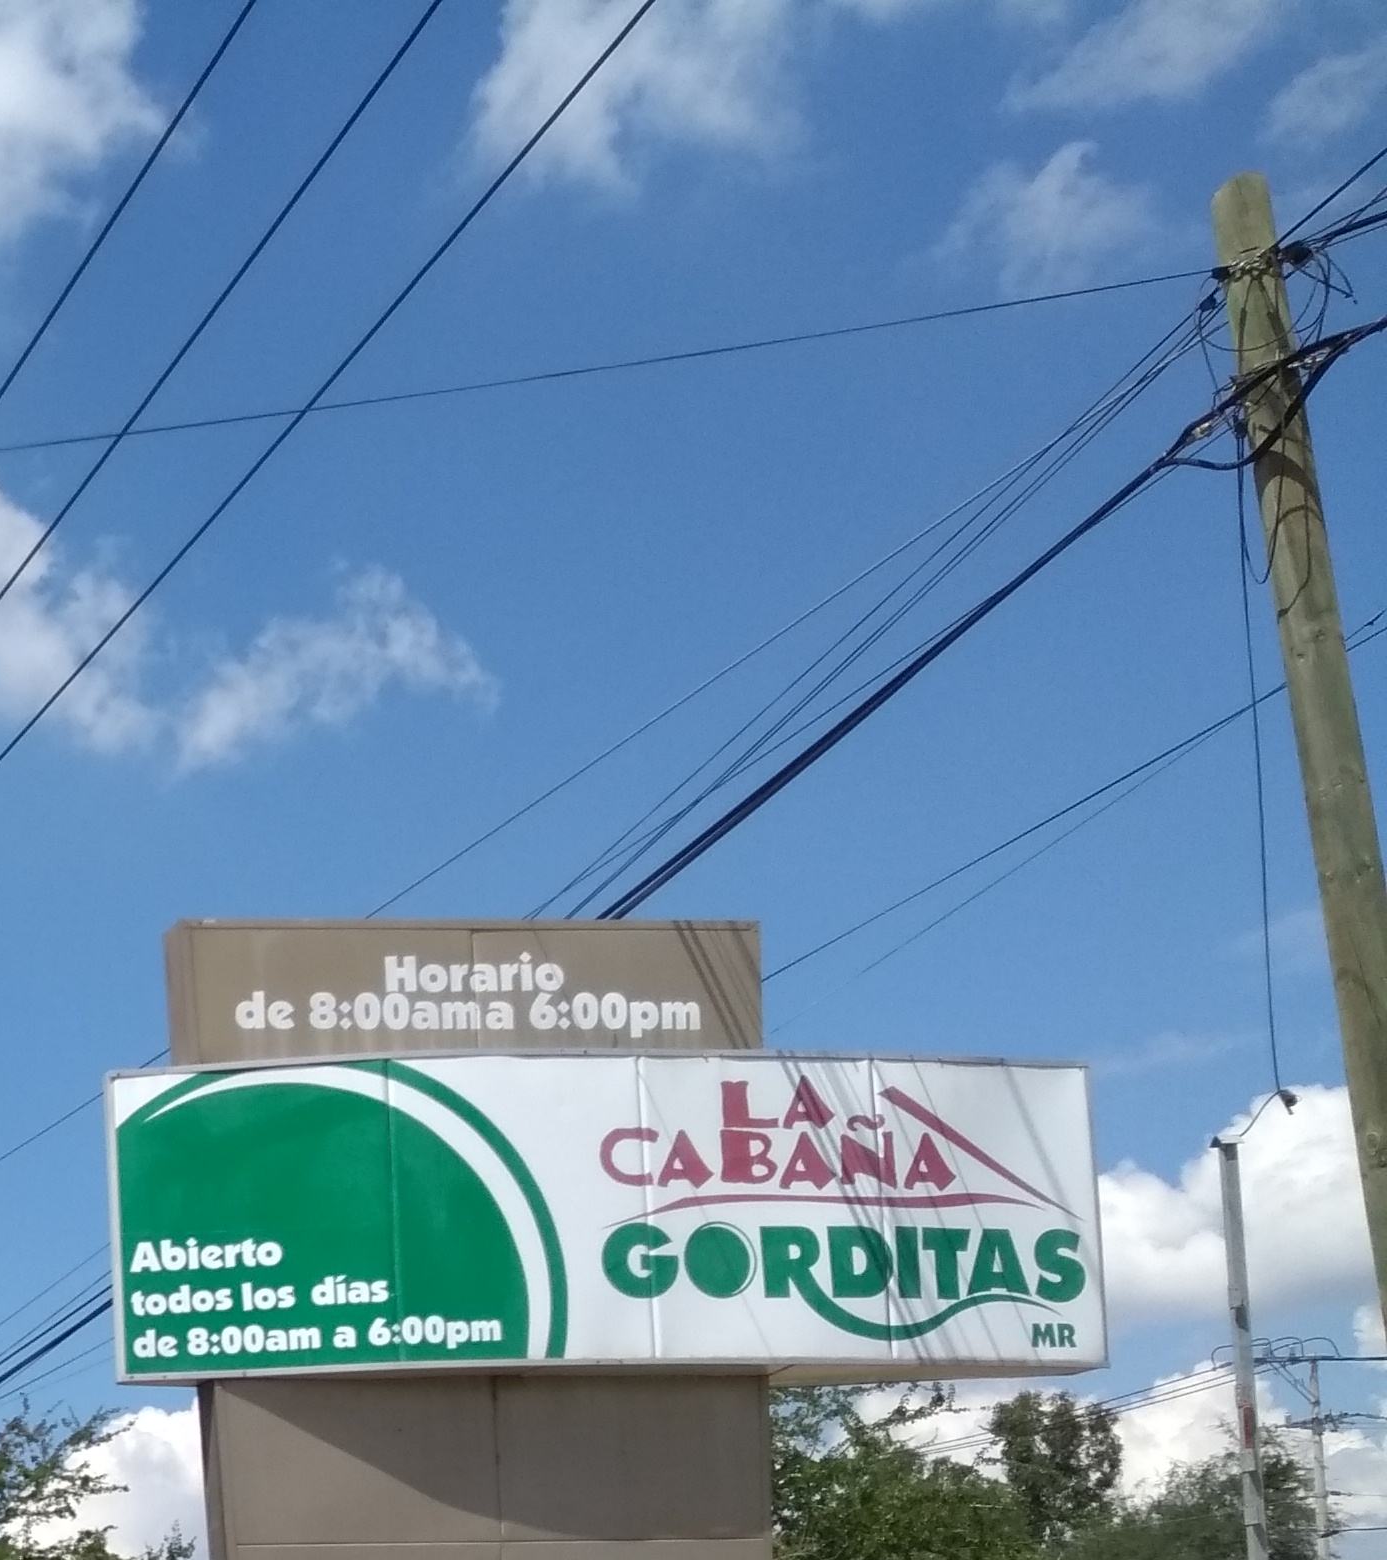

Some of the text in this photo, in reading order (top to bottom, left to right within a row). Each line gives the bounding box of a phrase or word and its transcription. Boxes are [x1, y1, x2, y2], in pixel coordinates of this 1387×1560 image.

[383, 951, 565, 993] Horario
[234, 990, 295, 1030] de
[529, 992, 702, 1039] 6:00pm
[720, 1075, 836, 1131] LA
[599, 1114, 957, 1191] CABAÑA
[130, 1237, 284, 1273] Abierto
[601, 1221, 1088, 1322] GORDITAS
[131, 1274, 390, 1317] todos los días
[133, 1315, 502, 1358] de 8:00am a 6:00pm
[1030, 1322, 1078, 1349] MR
